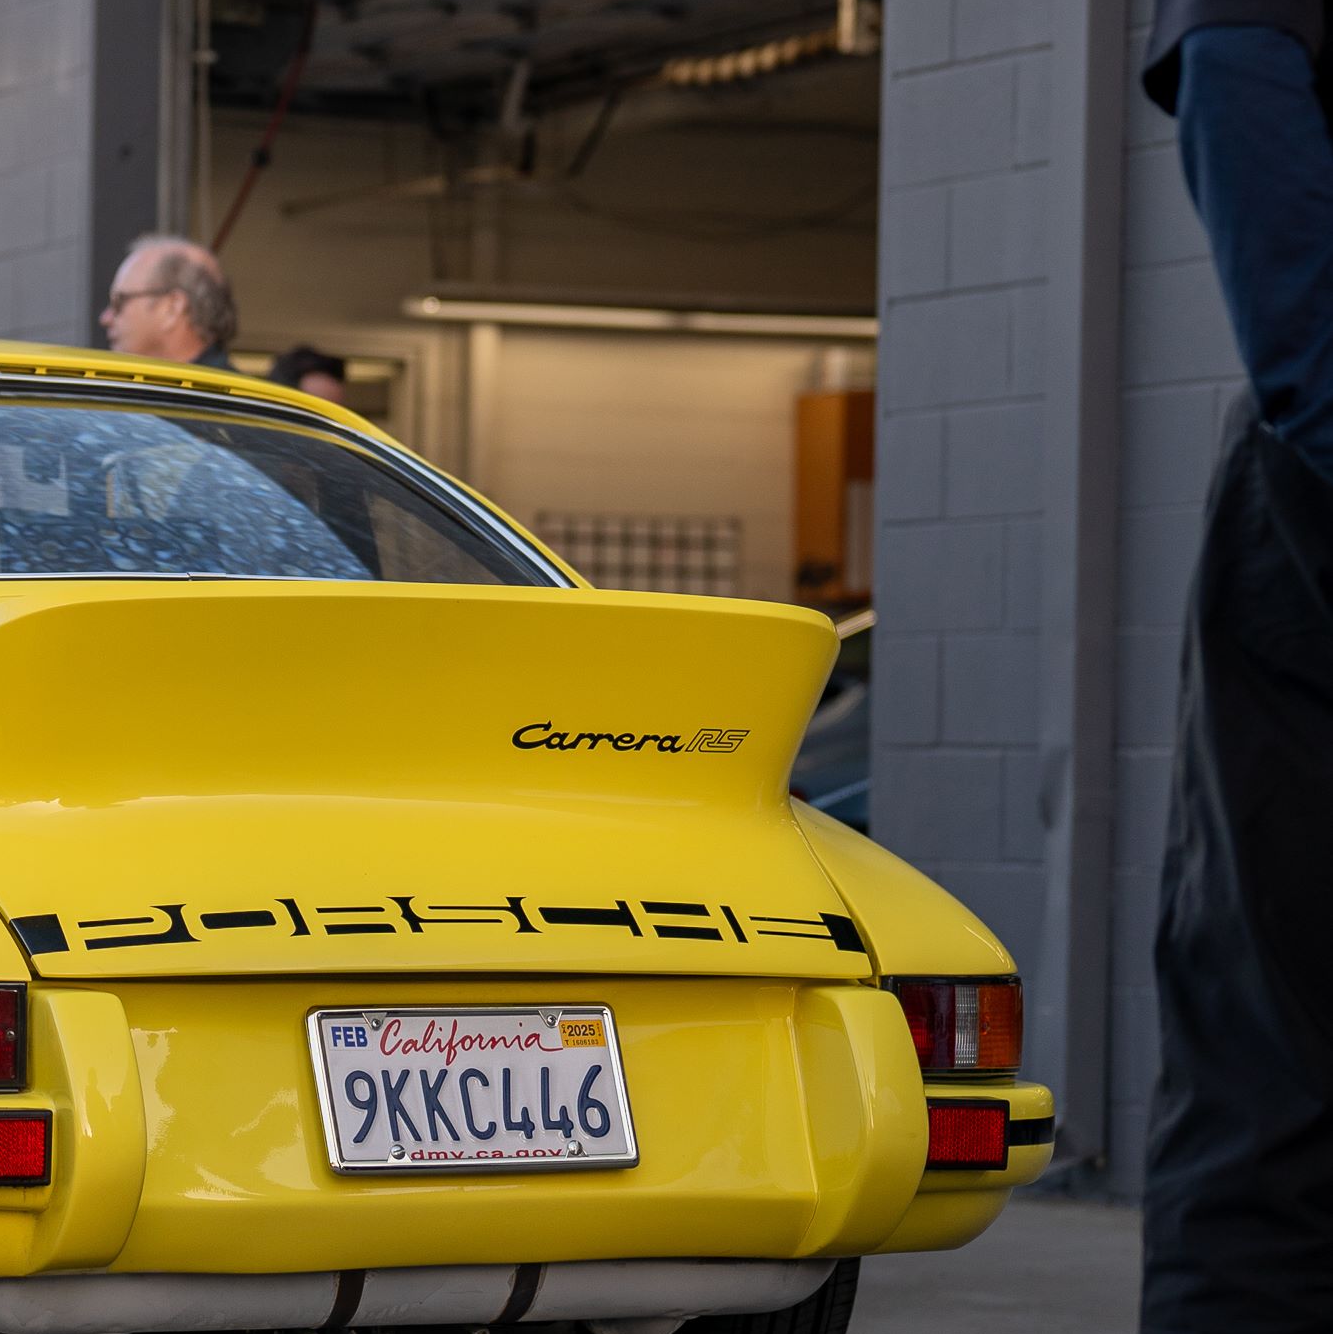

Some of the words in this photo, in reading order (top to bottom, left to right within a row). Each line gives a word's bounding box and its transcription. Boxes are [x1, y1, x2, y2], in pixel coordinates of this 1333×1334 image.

[512, 720, 686, 753] Carrera
[684, 728, 751, 753] RS
[332, 1026, 368, 1048] FEB
[379, 1019, 564, 1066] California
[567, 1024, 596, 1037] 2025
[344, 1064, 611, 1144] 9KKC446
